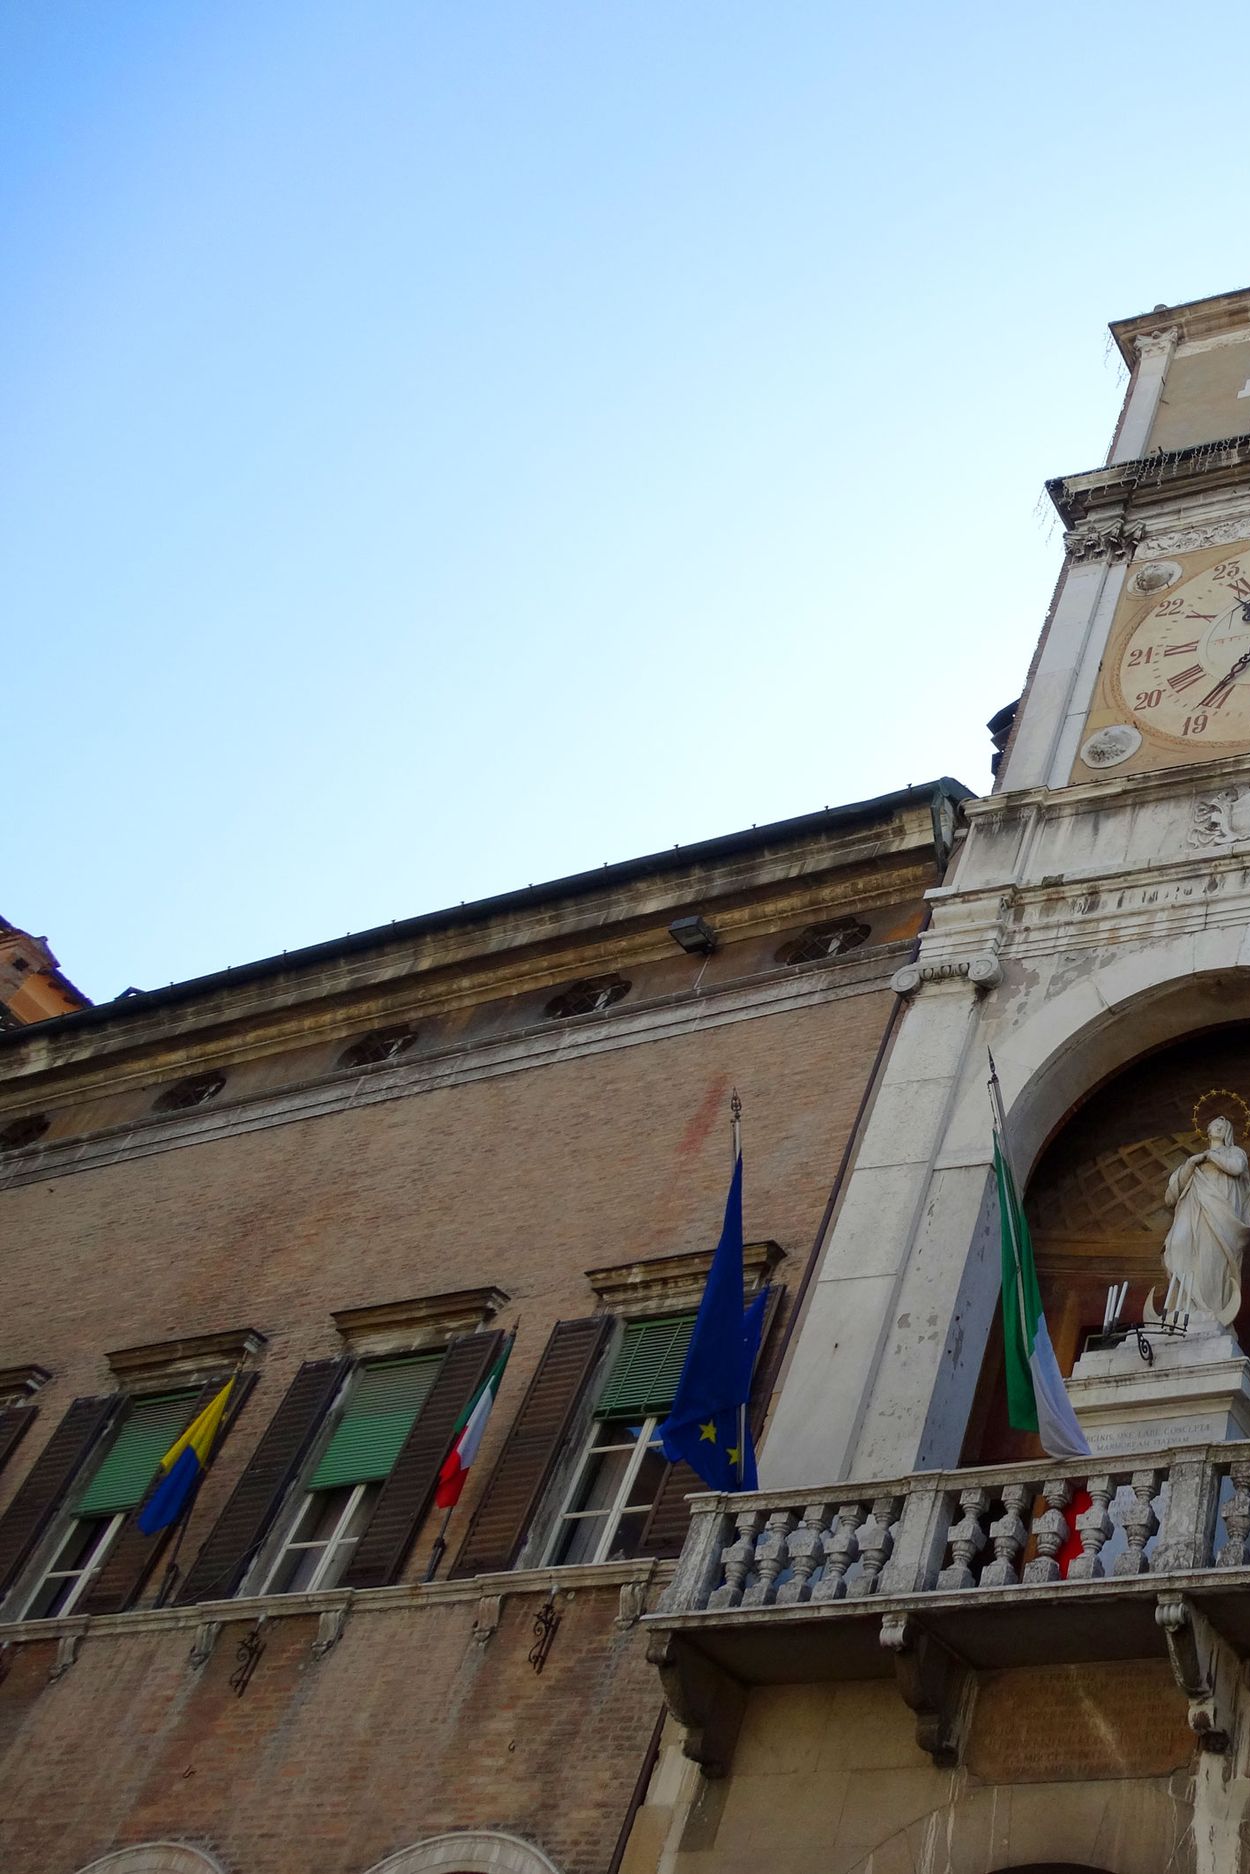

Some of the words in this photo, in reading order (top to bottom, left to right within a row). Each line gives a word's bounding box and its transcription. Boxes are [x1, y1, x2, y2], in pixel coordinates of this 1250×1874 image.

[1212, 560, 1240, 581] 23
[1155, 598, 1185, 617] 22
[1127, 646, 1153, 667] 21
[1133, 689, 1162, 711] 20
[1181, 714, 1208, 736] 19
